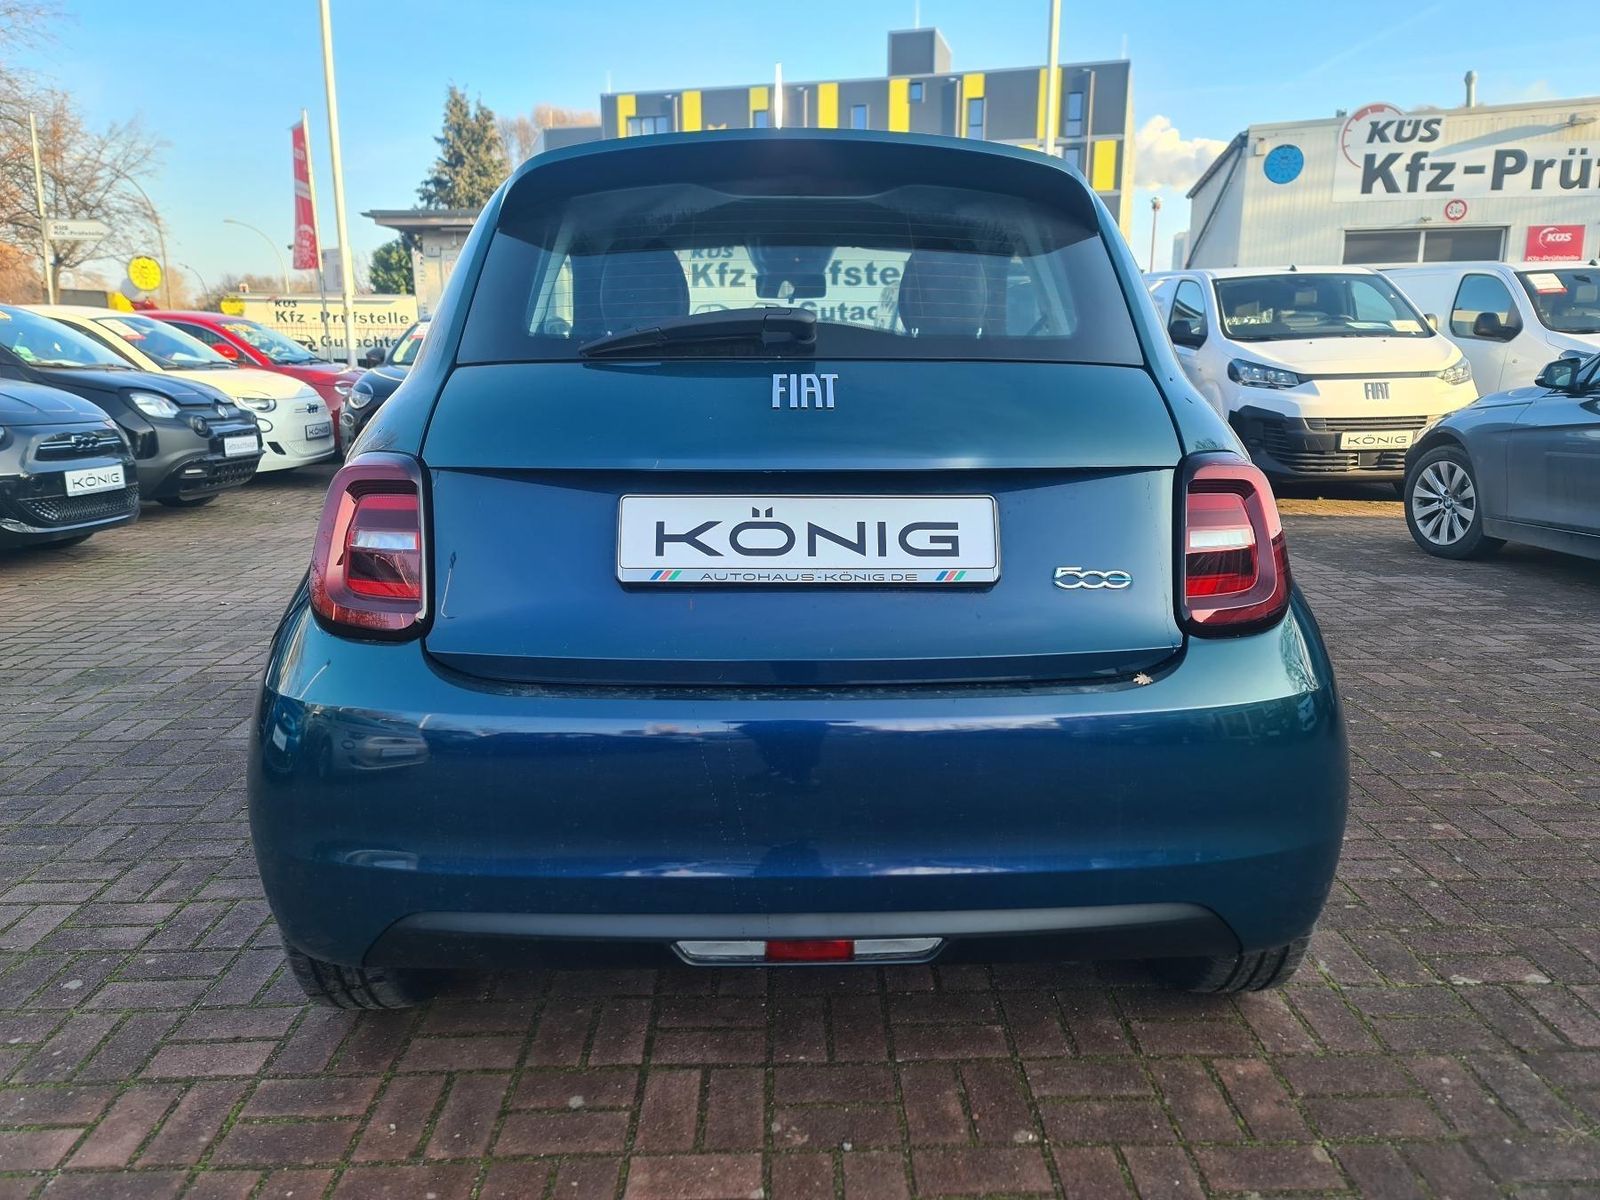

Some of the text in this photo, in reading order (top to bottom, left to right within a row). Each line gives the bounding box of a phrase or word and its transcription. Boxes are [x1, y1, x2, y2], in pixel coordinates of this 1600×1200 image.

[1366, 117, 1442, 144] KÜS
[1360, 147, 1600, 195] Kfz-Prü
[772, 373, 839, 408] FIAT
[1363, 382, 1390, 400] FIAT
[1347, 434, 1408, 445] KÖNIG
[71, 473, 121, 489] KÖNIG
[655, 506, 960, 558] KÖNIG
[700, 571, 918, 582] AUTOHAUS-KÖNIG.DE
[1053, 566, 1133, 590] 500
